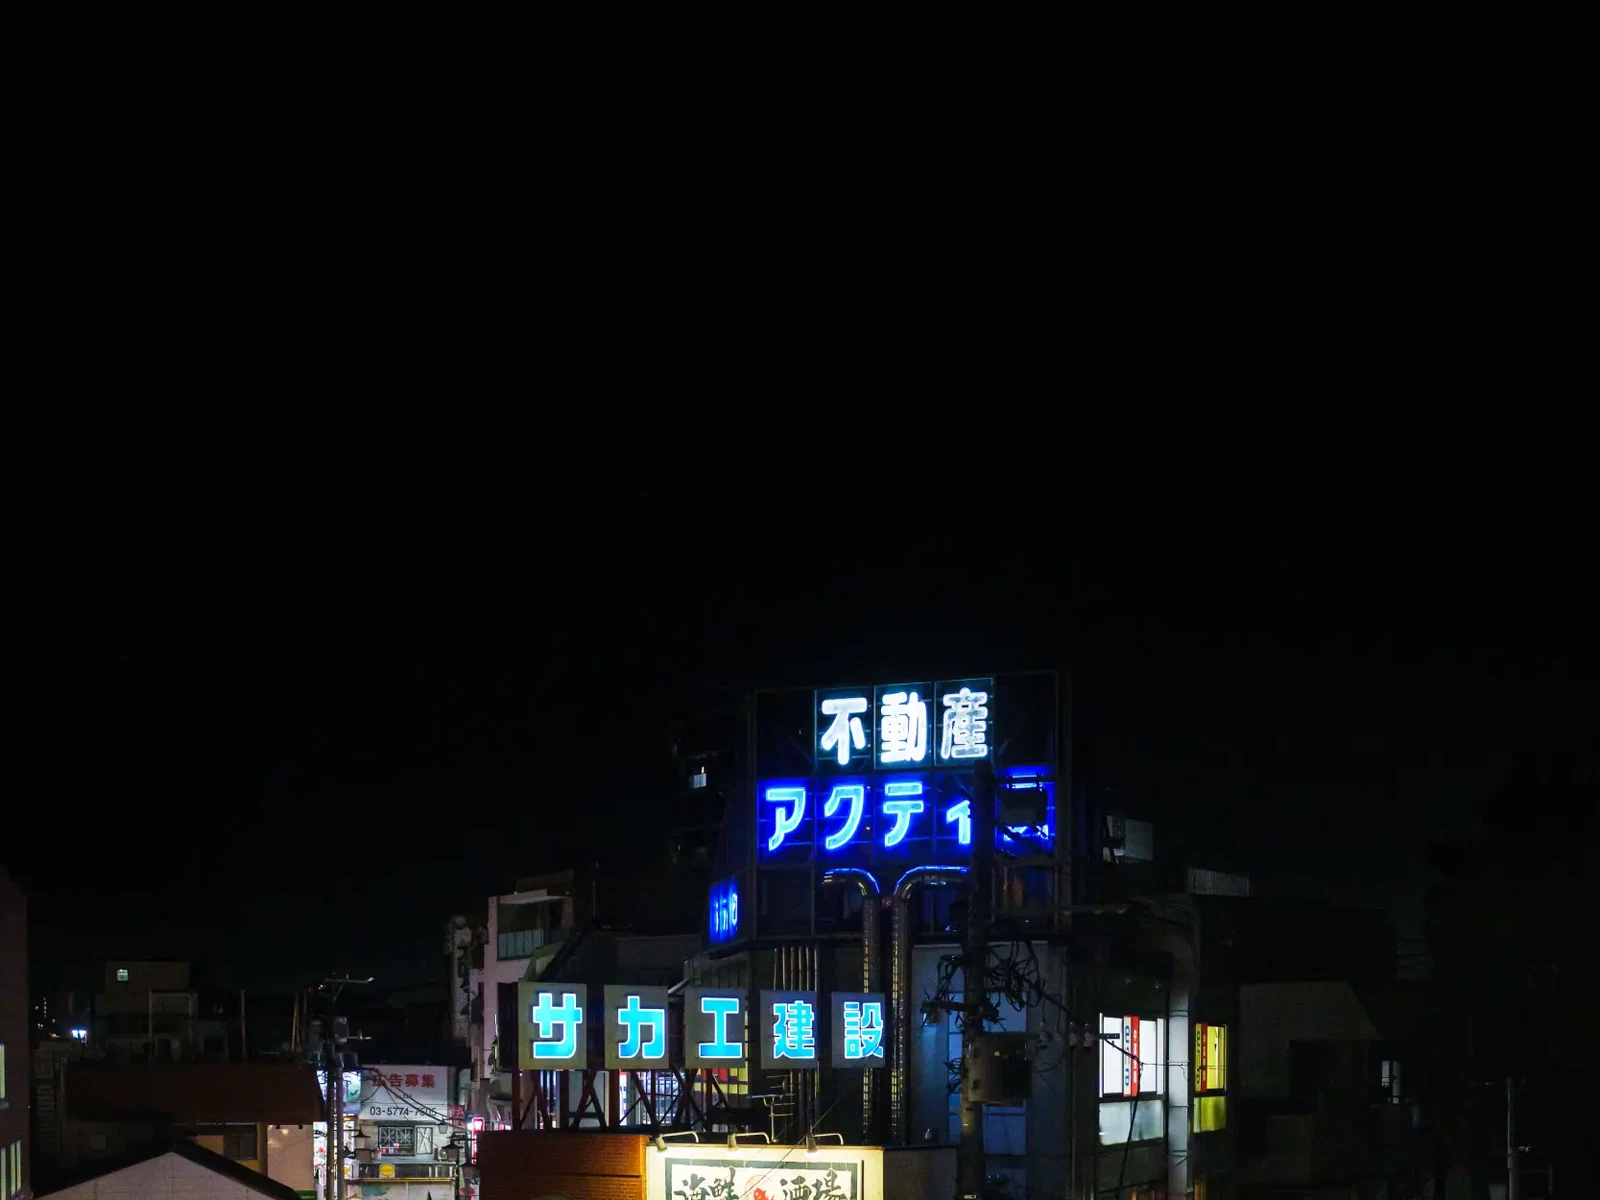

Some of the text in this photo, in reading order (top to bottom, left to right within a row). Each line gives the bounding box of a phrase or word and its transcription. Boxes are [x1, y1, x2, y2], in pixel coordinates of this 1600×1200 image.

[820, 686, 989, 766] 不動産
[765, 775, 1049, 851] アクティ
[532, 992, 884, 1060] サカエ建設
